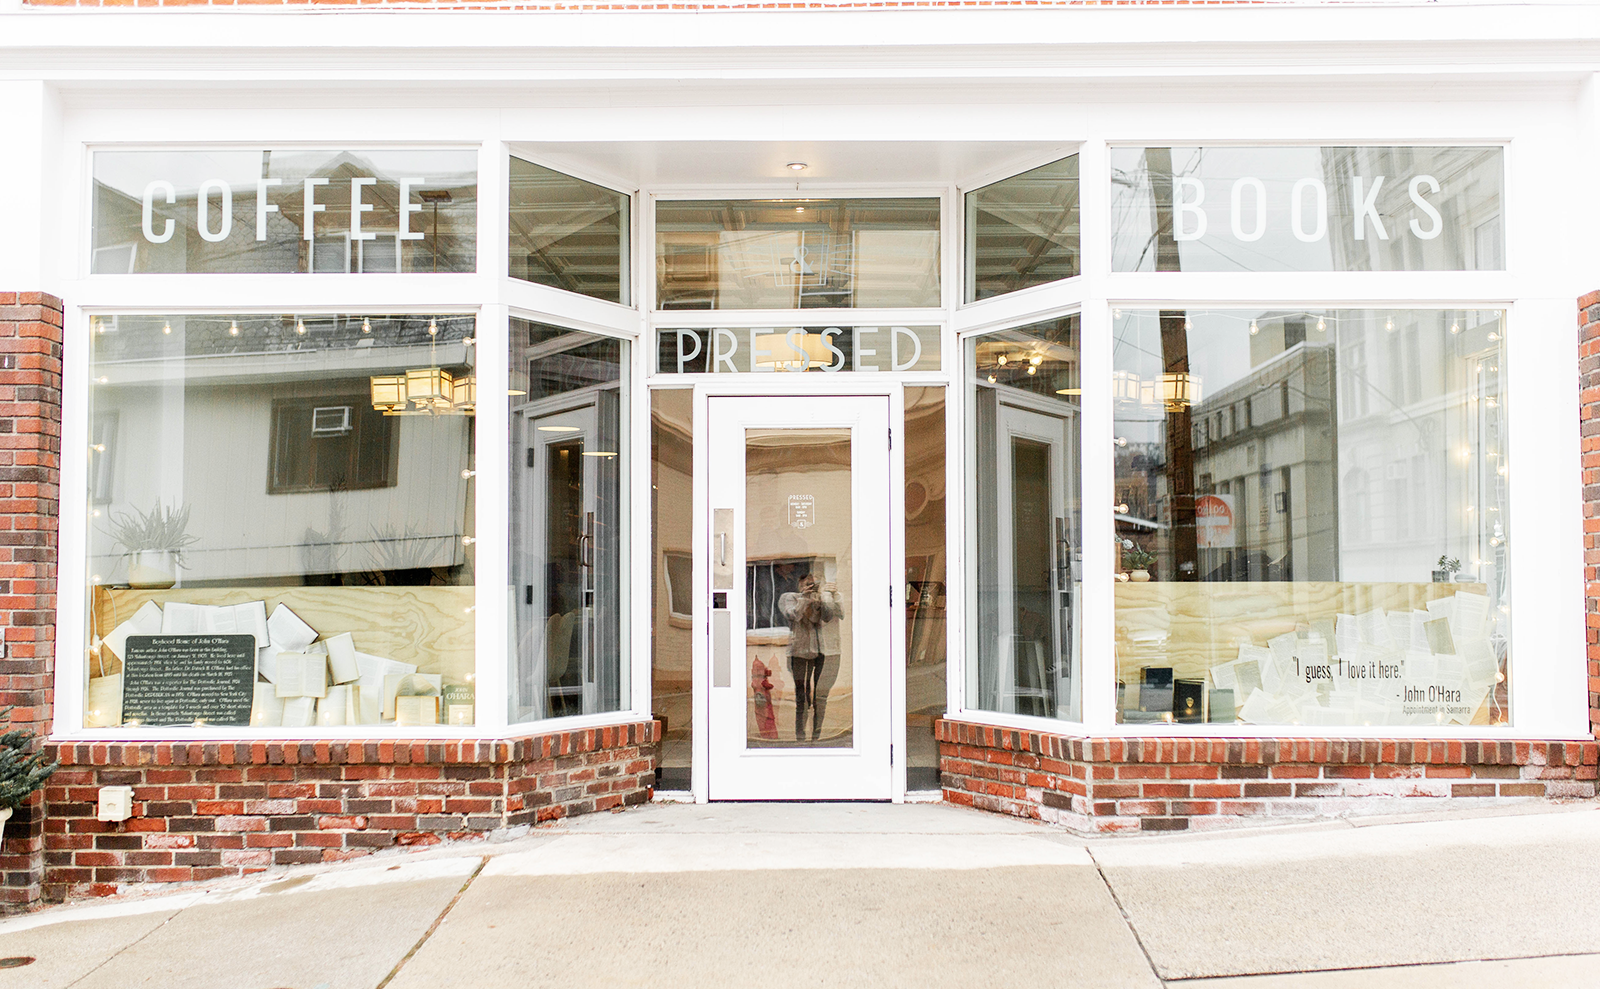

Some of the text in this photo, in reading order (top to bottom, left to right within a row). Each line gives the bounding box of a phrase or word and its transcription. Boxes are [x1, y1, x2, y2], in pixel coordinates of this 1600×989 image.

[141, 177, 425, 243] COFFEE
[1172, 174, 1443, 243] BOOKS
[790, 246, 814, 273] &
[677, 326, 922, 373] PRESSED
[1305, 666, 1334, 683] guess,
[1348, 661, 1366, 679] love
[1369, 661, 1376, 679] it
[1403, 686, 1425, 702] John
[1429, 685, 1461, 702] O'Hara
[1402, 705, 1437, 714] Appointment
[1446, 705, 1471, 714] Samarra
